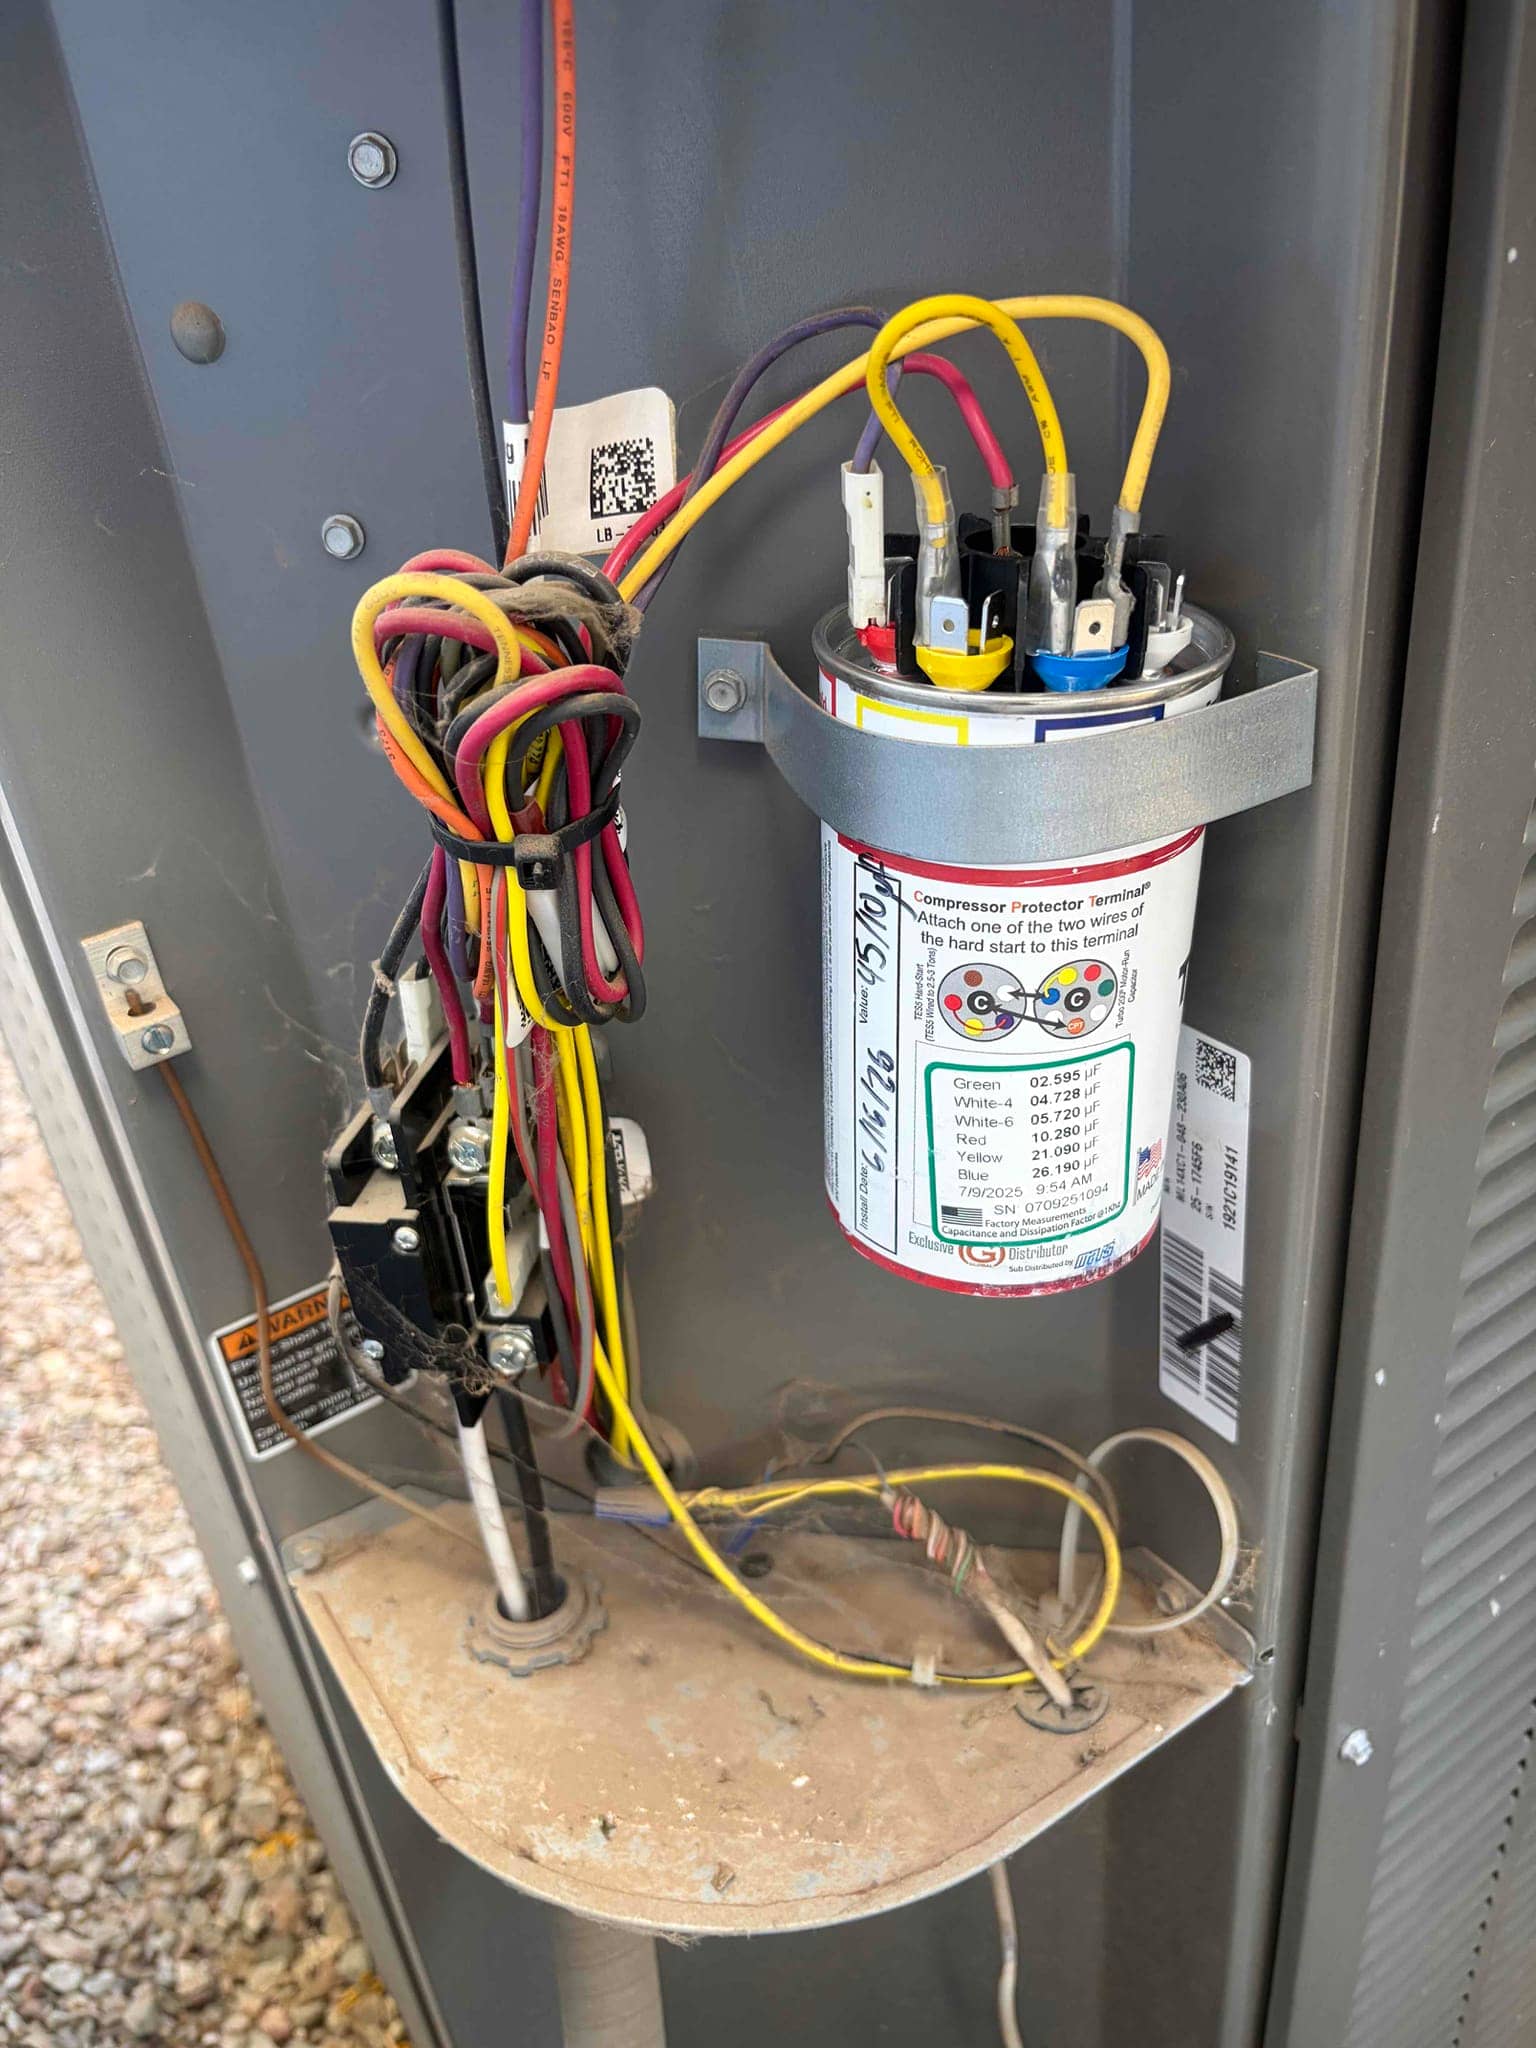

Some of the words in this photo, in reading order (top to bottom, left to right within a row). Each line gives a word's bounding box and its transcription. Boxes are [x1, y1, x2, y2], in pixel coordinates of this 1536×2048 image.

[555, 206, 568, 262] 18AWG
[547, 278, 562, 346] SENBAO
[913, 890, 1006, 914] Compressor
[1011, 899, 1084, 914] Protector
[917, 910, 966, 931] Attach
[971, 921, 1001, 934] one
[1007, 920, 1023, 934] of
[1028, 919, 1053, 934] the
[1058, 916, 1086, 931] two
[1091, 911, 1128, 928] wires
[1131, 902, 1145, 919] of
[921, 931, 944, 947] the
[949, 936, 984, 952] hard
[989, 940, 1025, 954] start
[1030, 941, 1046, 953] to
[1051, 937, 1078, 952] this
[1083, 924, 1139, 948] terminal
[914, 963, 924, 1000] Hard-Start
[859, 985, 869, 1024] Value:
[974, 996, 988, 1010] C
[1070, 991, 1084, 1007] C
[953, 1077, 1001, 1090] Green
[1029, 1070, 1081, 1088] 02.595
[954, 1096, 1013, 1109] White-4
[1029, 1088, 1081, 1107] 04.728
[955, 1114, 1014, 1128] White-6
[1030, 1107, 1081, 1126] 05.720
[956, 1133, 987, 1146] Red
[1031, 1125, 1081, 1143] 10.280
[956, 1150, 1003, 1163] Yellow
[1031, 1142, 1080, 1161] 21.090
[958, 1169, 989, 1181] Blue
[1031, 1160, 1080, 1178] 26.190
[958, 1186, 1024, 1199] 7/9/2025
[1035, 1180, 1067, 1195] 9:54
[1070, 1173, 1093, 1188] AM
[1025, 1182, 1109, 1213] 0709251094
[1222, 1145, 1239, 1231] 1921C19141
[859, 1194, 869, 1230] Install
[985, 1218, 1020, 1229] Factory
[1022, 1207, 1087, 1227] Measurements
[941, 1226, 998, 1238] Capacitance
[1000, 1227, 1017, 1237] and
[1020, 1222, 1069, 1237] Dissipation
[1071, 1212, 1096, 1227] Factor
[908, 1231, 955, 1256] Exclusive
[1008, 1244, 1068, 1261] Distributor
[1009, 1265, 1024, 1273] Sub
[1025, 1261, 1064, 1272] Distributed
